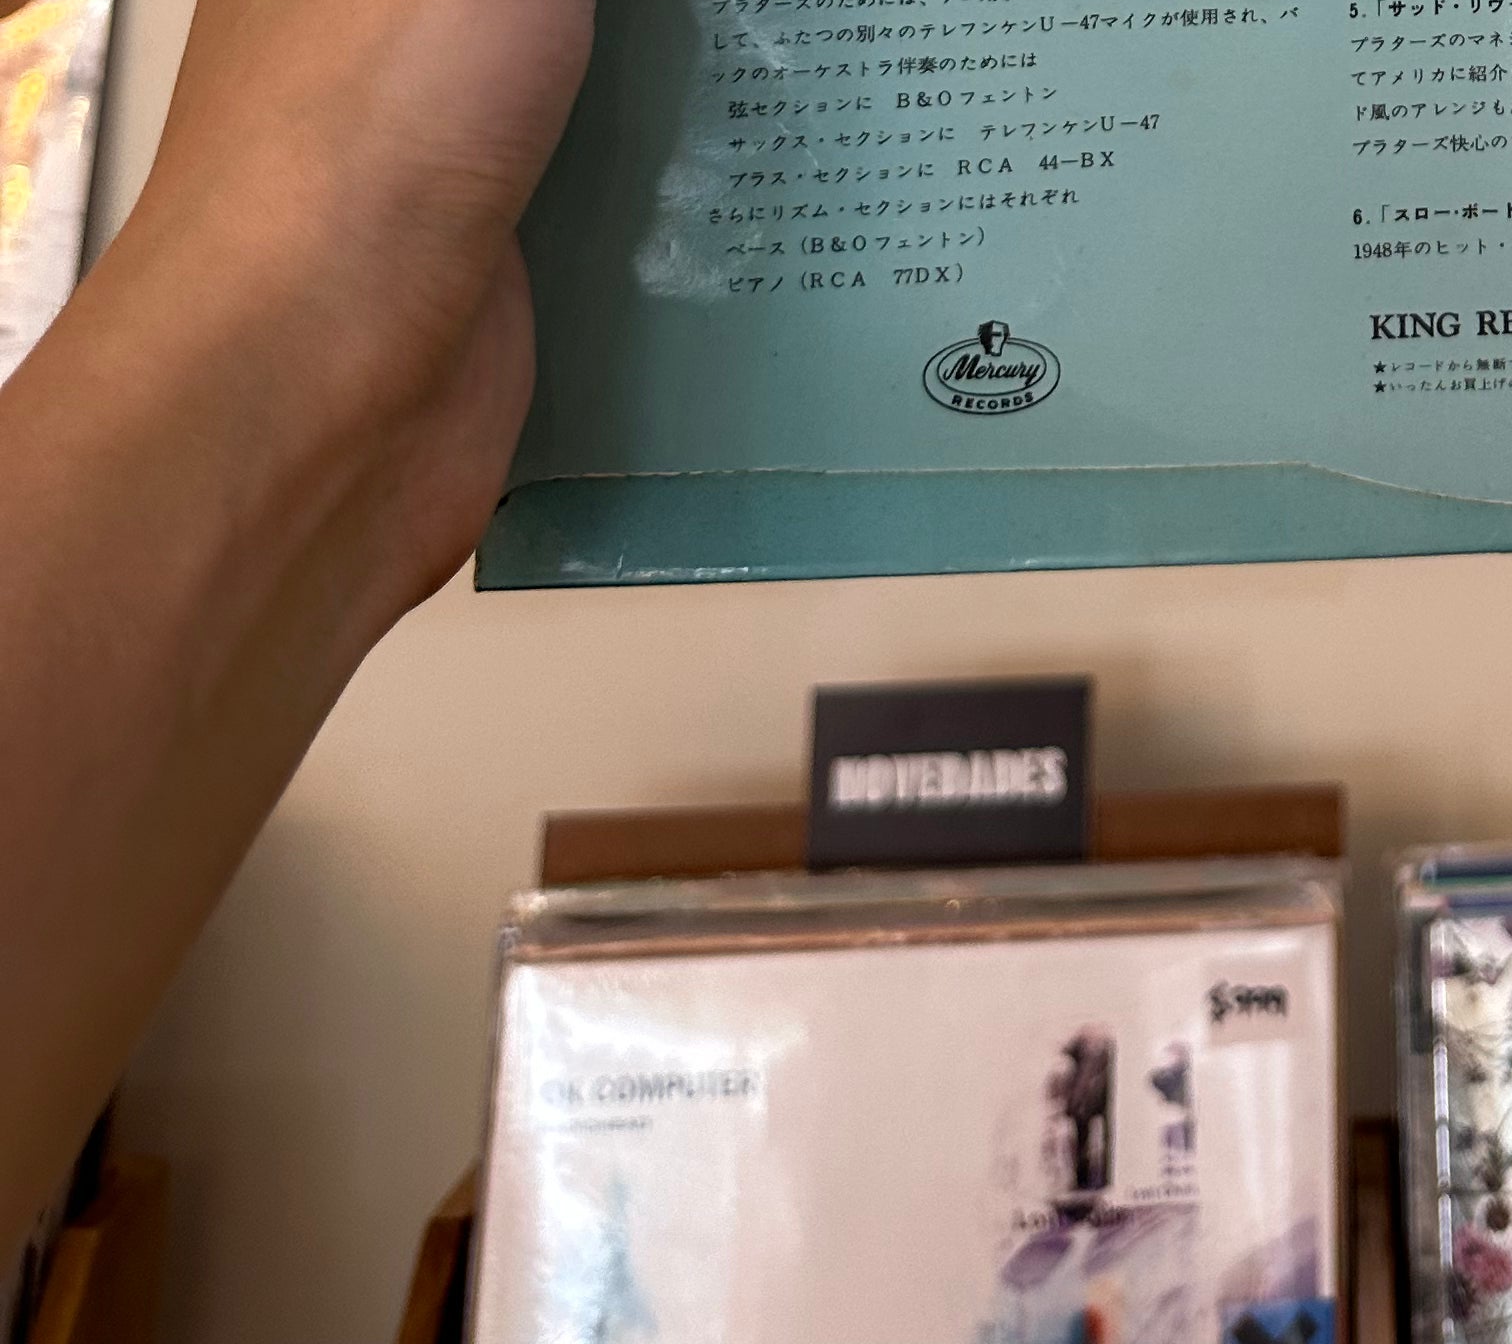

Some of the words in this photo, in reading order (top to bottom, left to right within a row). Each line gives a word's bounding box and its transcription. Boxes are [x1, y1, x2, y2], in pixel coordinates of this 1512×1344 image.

[1369, 312, 1461, 340] KING
[943, 354, 1041, 387] Mercury
[952, 392, 1034, 410] RECORDS
[829, 746, 1068, 804] NOVEDADES
[594, 1068, 762, 1104] COMPUTER
